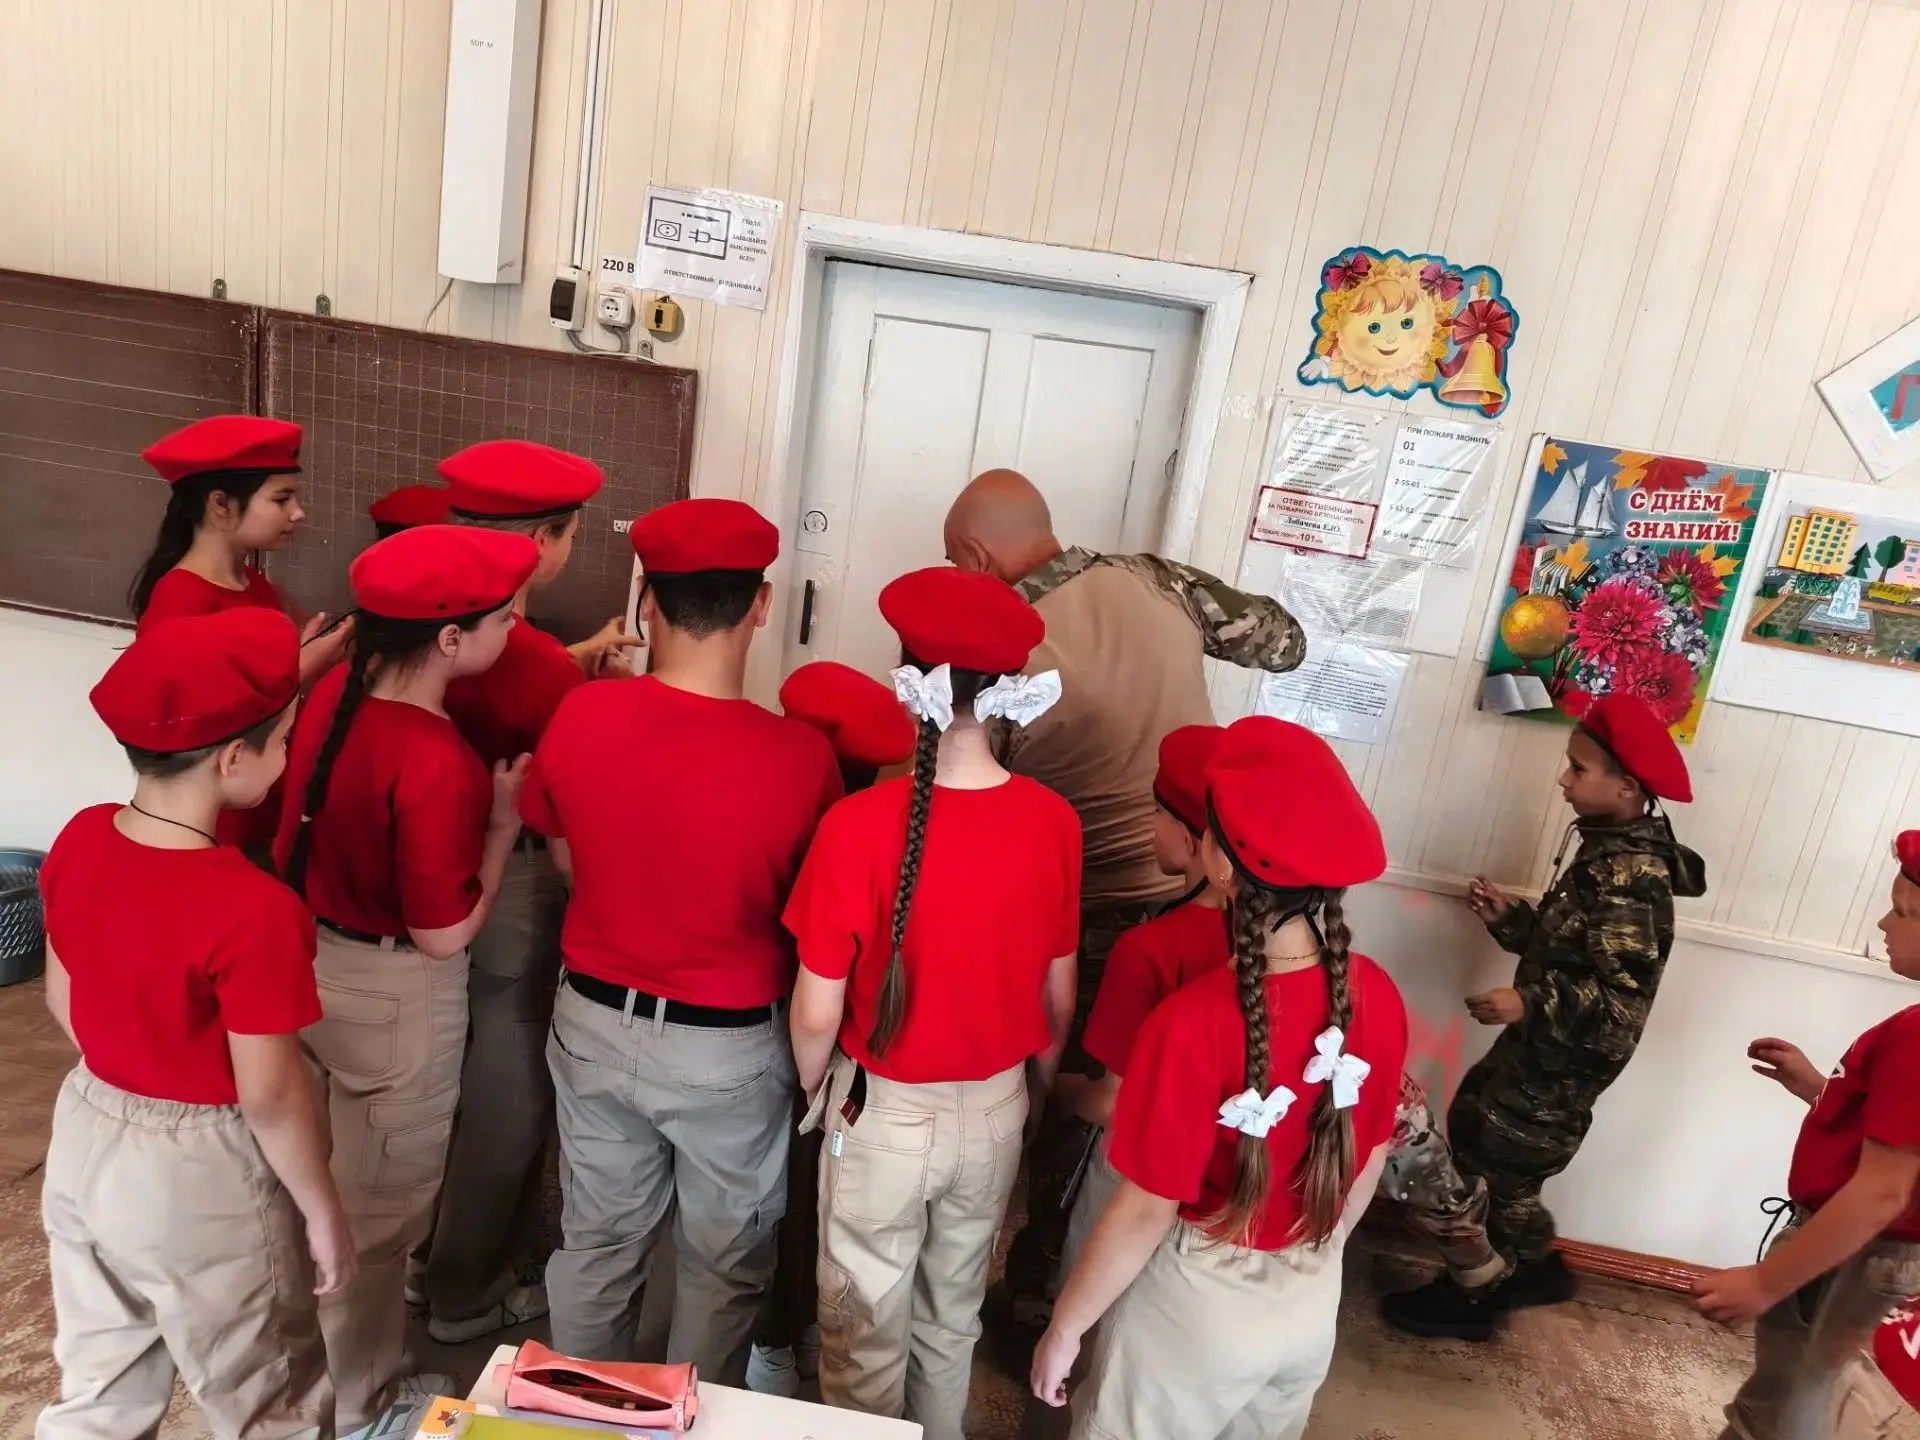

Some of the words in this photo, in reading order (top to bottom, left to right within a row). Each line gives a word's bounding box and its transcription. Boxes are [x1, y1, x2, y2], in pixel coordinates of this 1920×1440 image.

[602, 258, 624, 273] 220
[627, 263, 635, 274] В
[1406, 426, 1422, 435] ПРИ
[1423, 429, 1454, 440] ПОЖАРЕ
[1402, 440, 1416, 452] 01
[1282, 497, 1353, 515] ОТВЕТСТВЕННЫЙ
[1629, 491, 1647, 511] С
[1650, 489, 1724, 514] ДНЁМ
[1276, 504, 1314, 517] ПОЖАРНУЮ
[1300, 533, 1316, 543] 101
[1625, 519, 1740, 542] ЗНАНИЙ!
